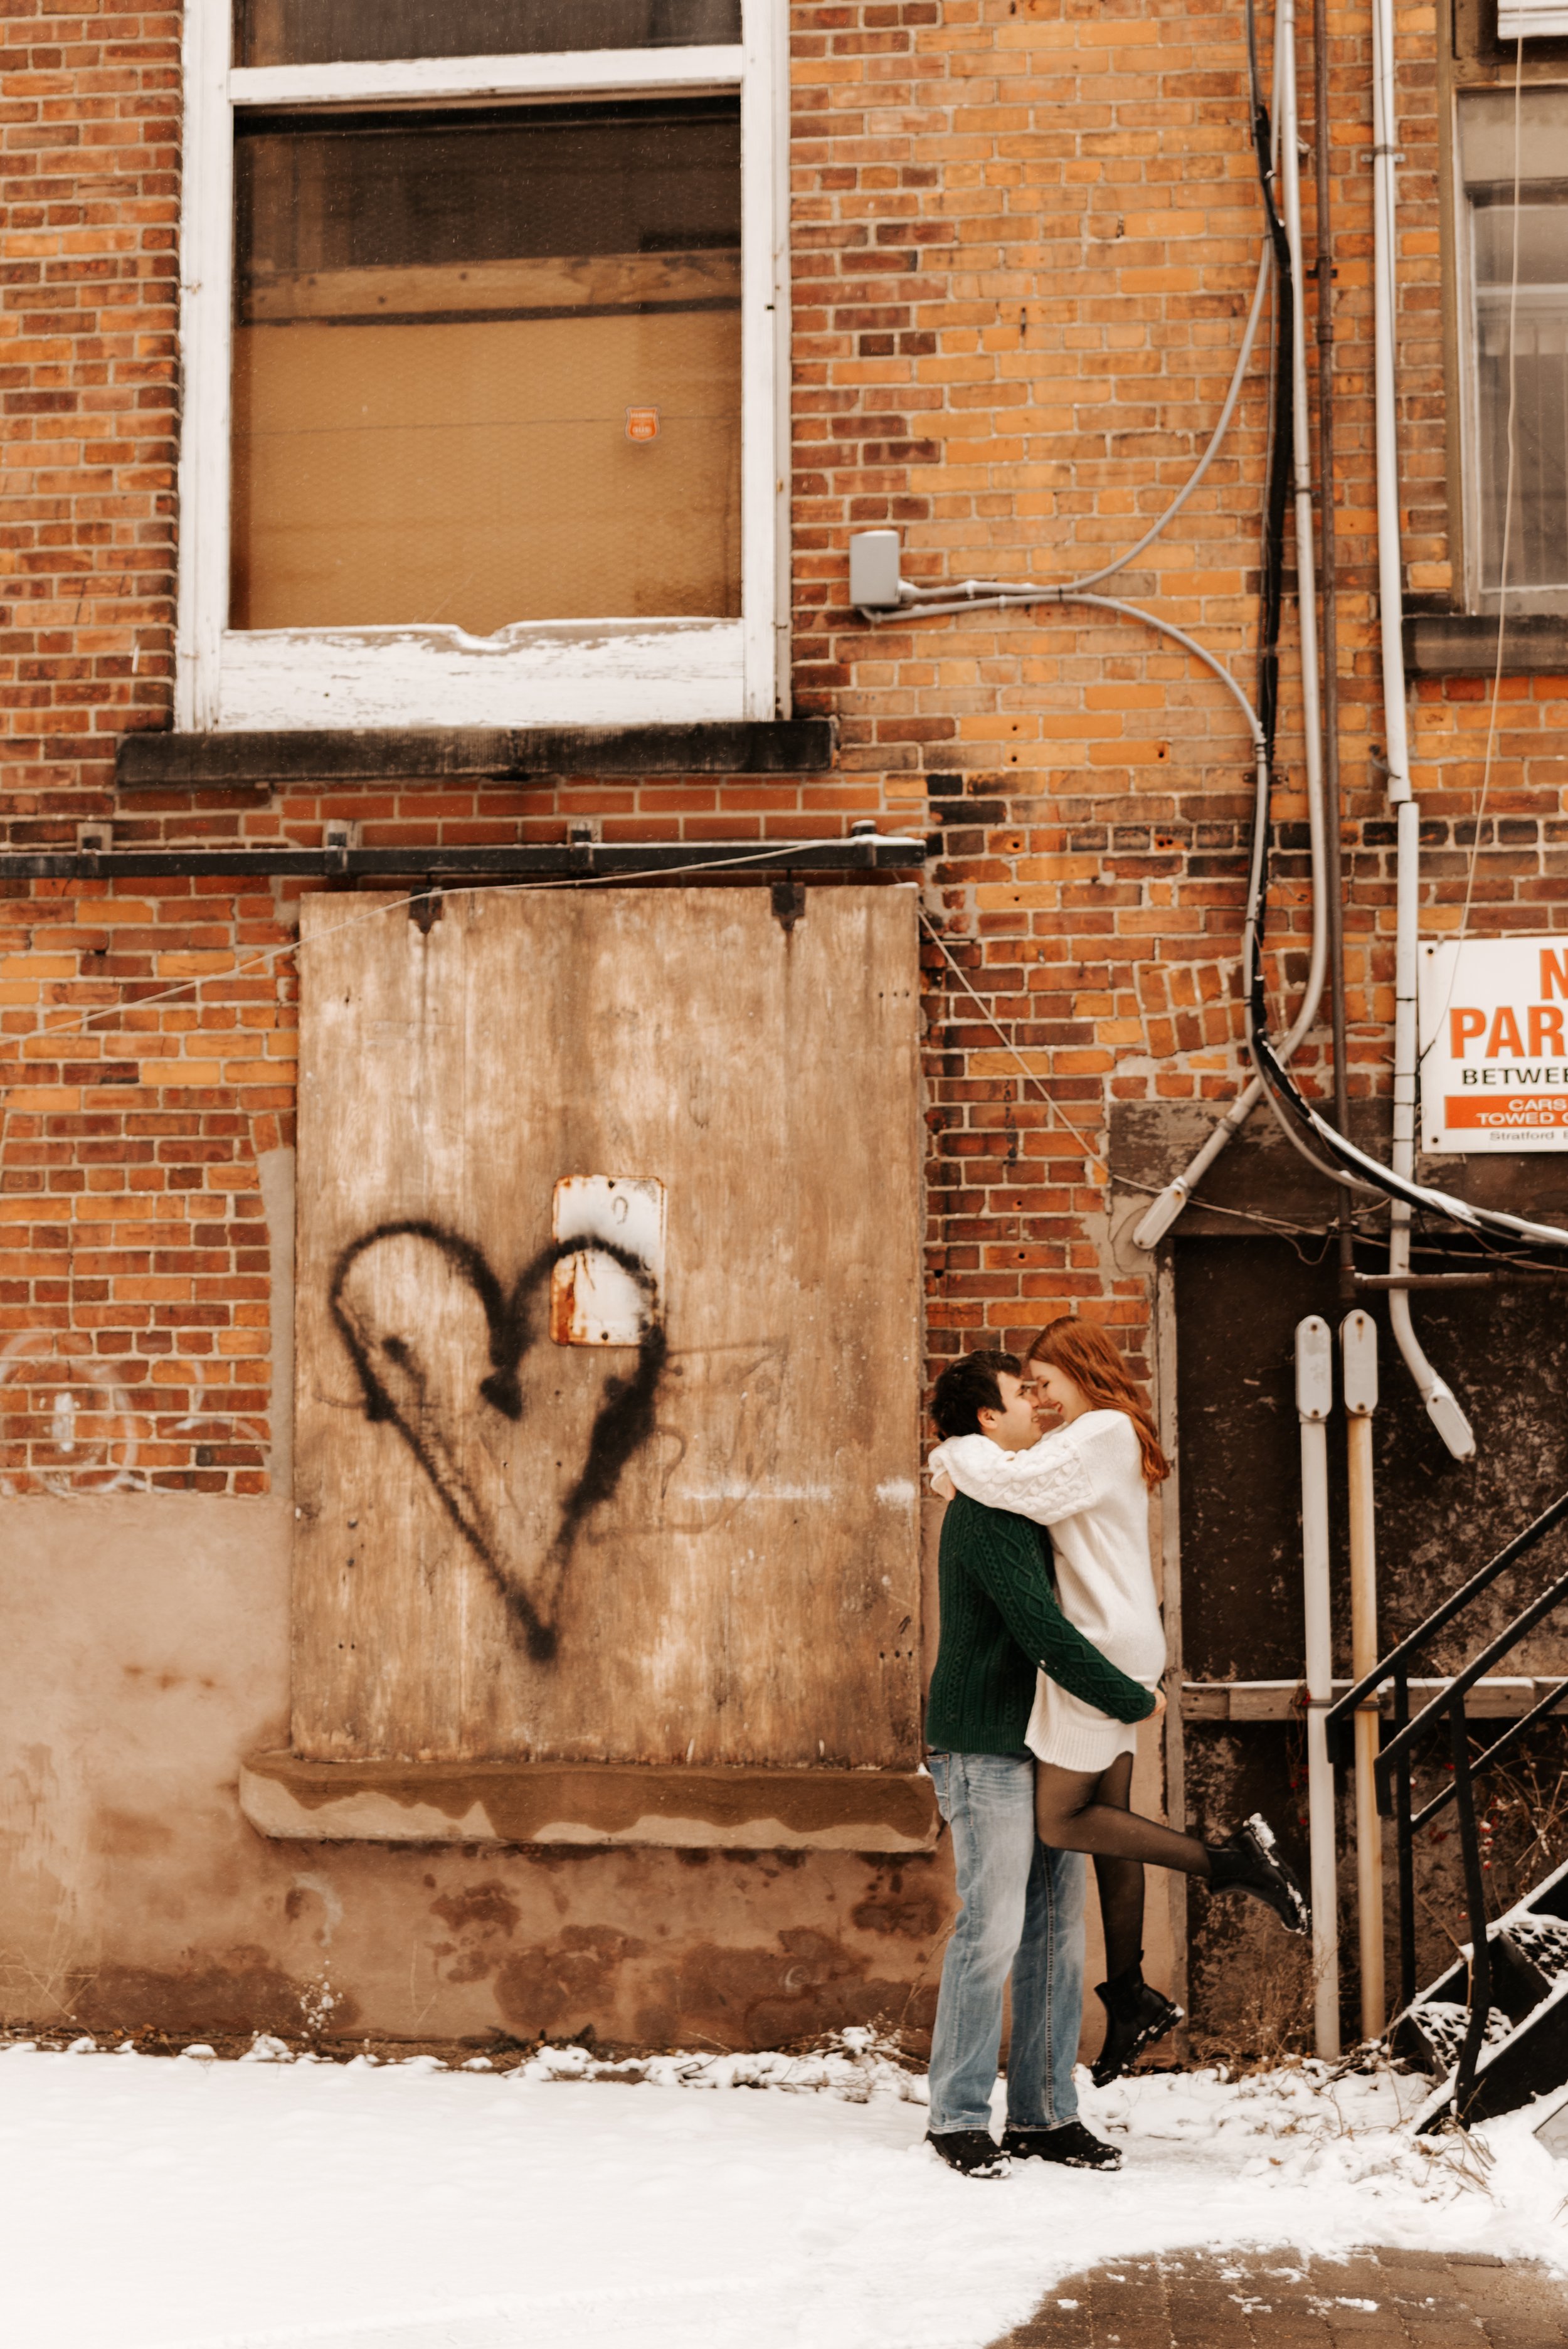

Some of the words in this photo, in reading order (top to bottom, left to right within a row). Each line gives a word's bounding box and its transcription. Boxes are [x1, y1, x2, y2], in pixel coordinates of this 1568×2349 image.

[1449, 1005, 1567, 1059] PAR
[1508, 1098, 1567, 1112] CARS
[1476, 1111, 1555, 1125] TOWED
[1490, 1130, 1554, 1141] Stratford
